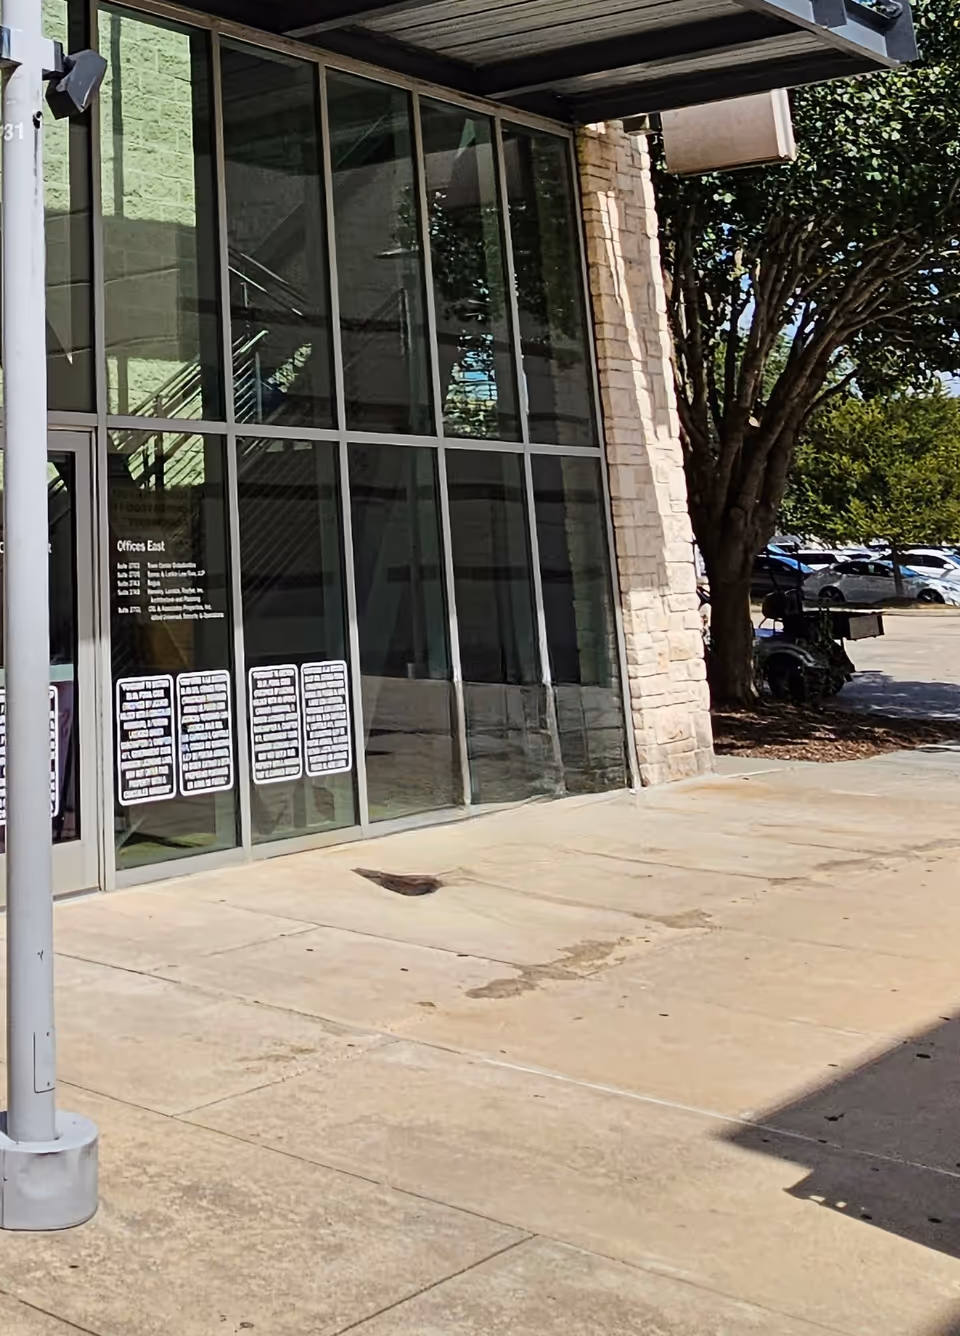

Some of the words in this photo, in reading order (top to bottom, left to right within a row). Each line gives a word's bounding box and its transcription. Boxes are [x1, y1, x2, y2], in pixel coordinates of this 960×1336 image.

[4, 122, 24, 141] 31
[117, 540, 145, 552] Offices
[147, 540, 165, 552] East
